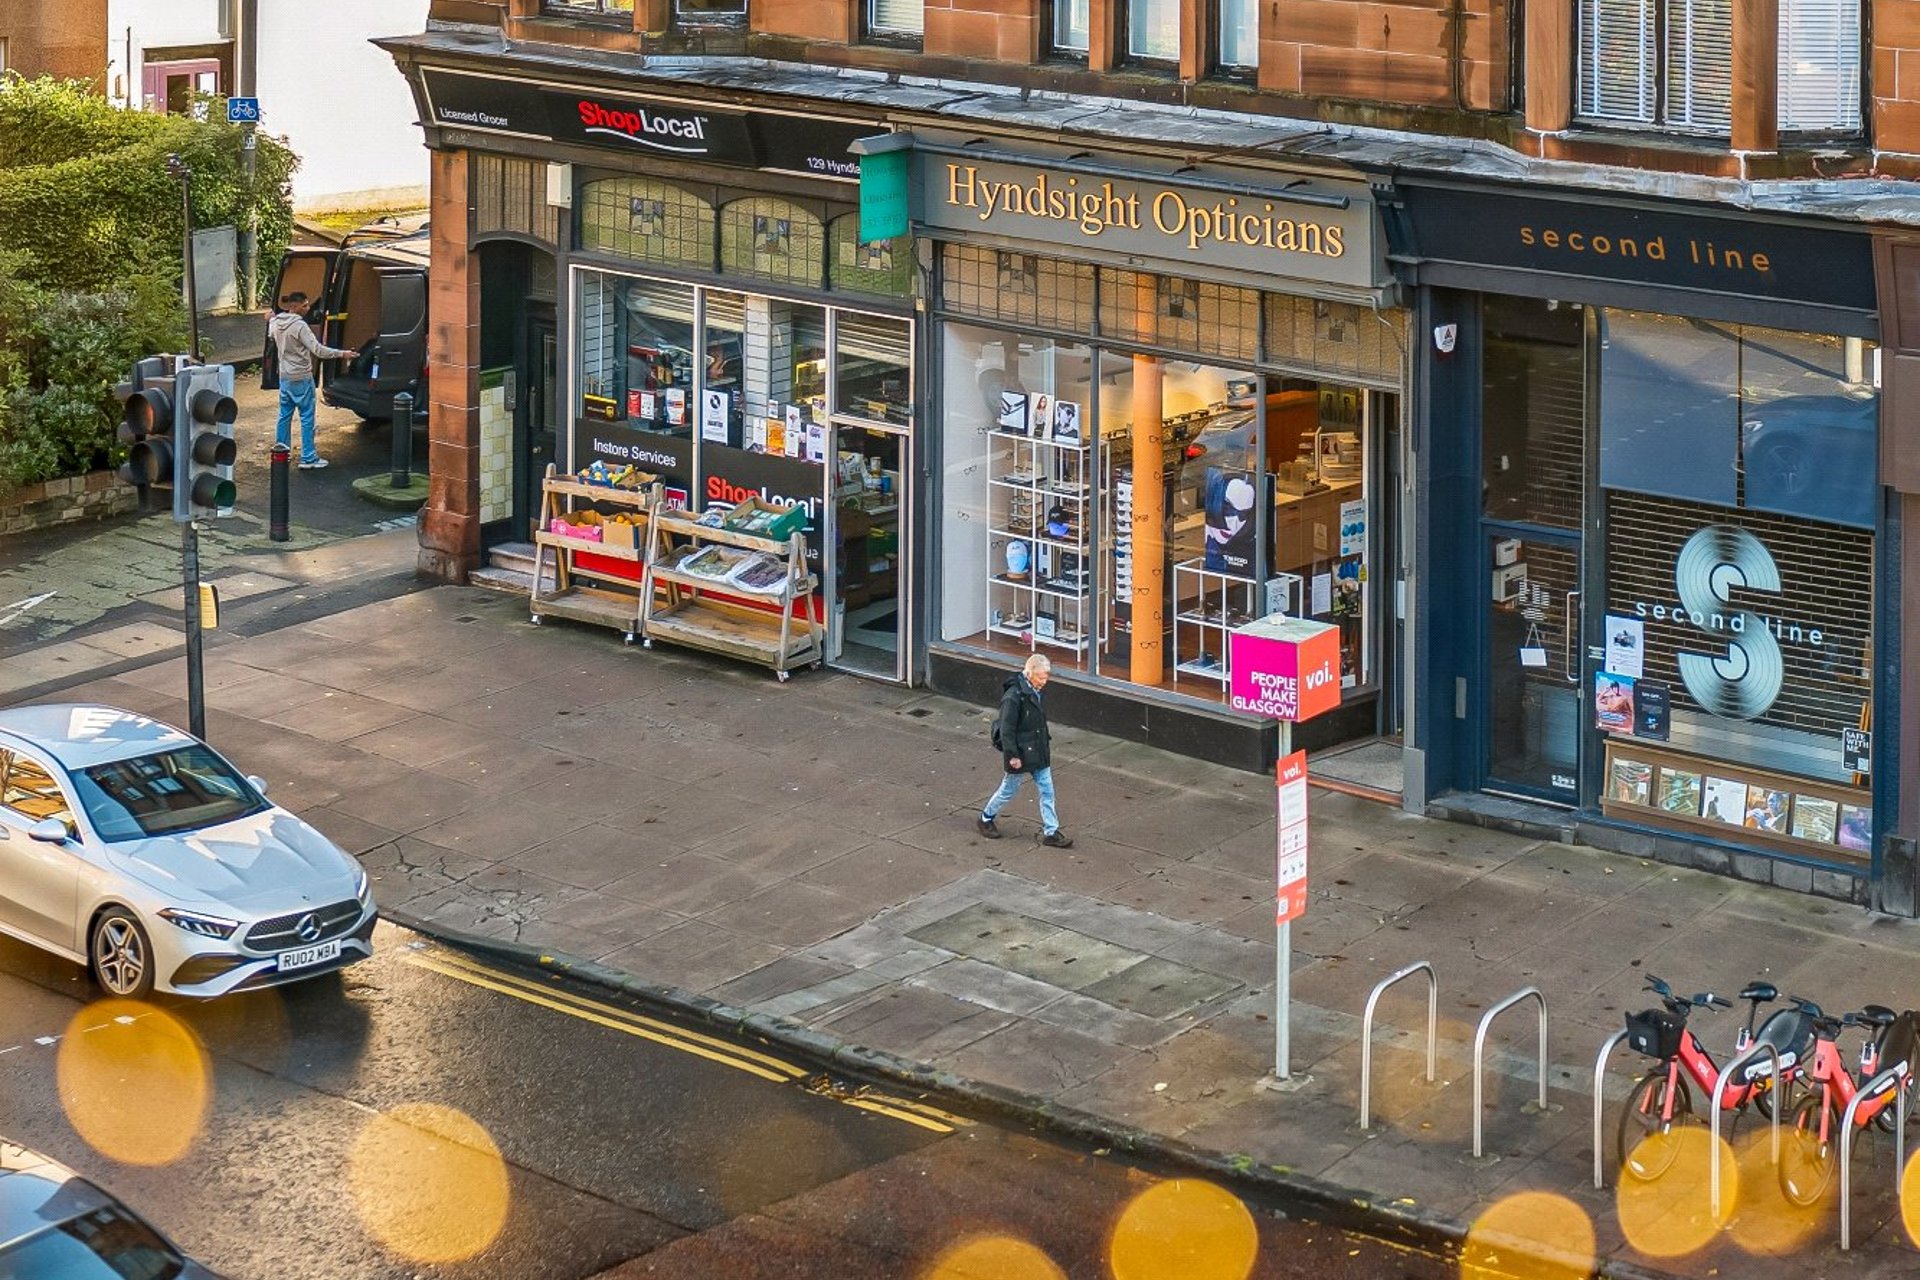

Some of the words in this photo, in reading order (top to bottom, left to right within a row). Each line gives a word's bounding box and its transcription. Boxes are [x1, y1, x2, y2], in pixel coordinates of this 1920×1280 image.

[439, 106, 478, 122] Licensed
[479, 112, 508, 126] Grocer
[807, 157, 825, 170] 129
[946, 163, 1142, 236] Hyndsight
[1152, 190, 1345, 259] Opticians
[1520, 225, 1666, 261] second
[1690, 240, 1770, 271] line
[594, 438, 629, 458] Instore
[631, 446, 677, 467] Services
[1635, 601, 1745, 633] second
[1765, 617, 1823, 645] line
[1251, 671, 1297, 691] PEOPLE
[1261, 687, 1297, 705] MAKE
[1233, 695, 1297, 718] GLASGOW
[1846, 738, 1869, 749] WITH
[284, 951, 314, 967] RU02
